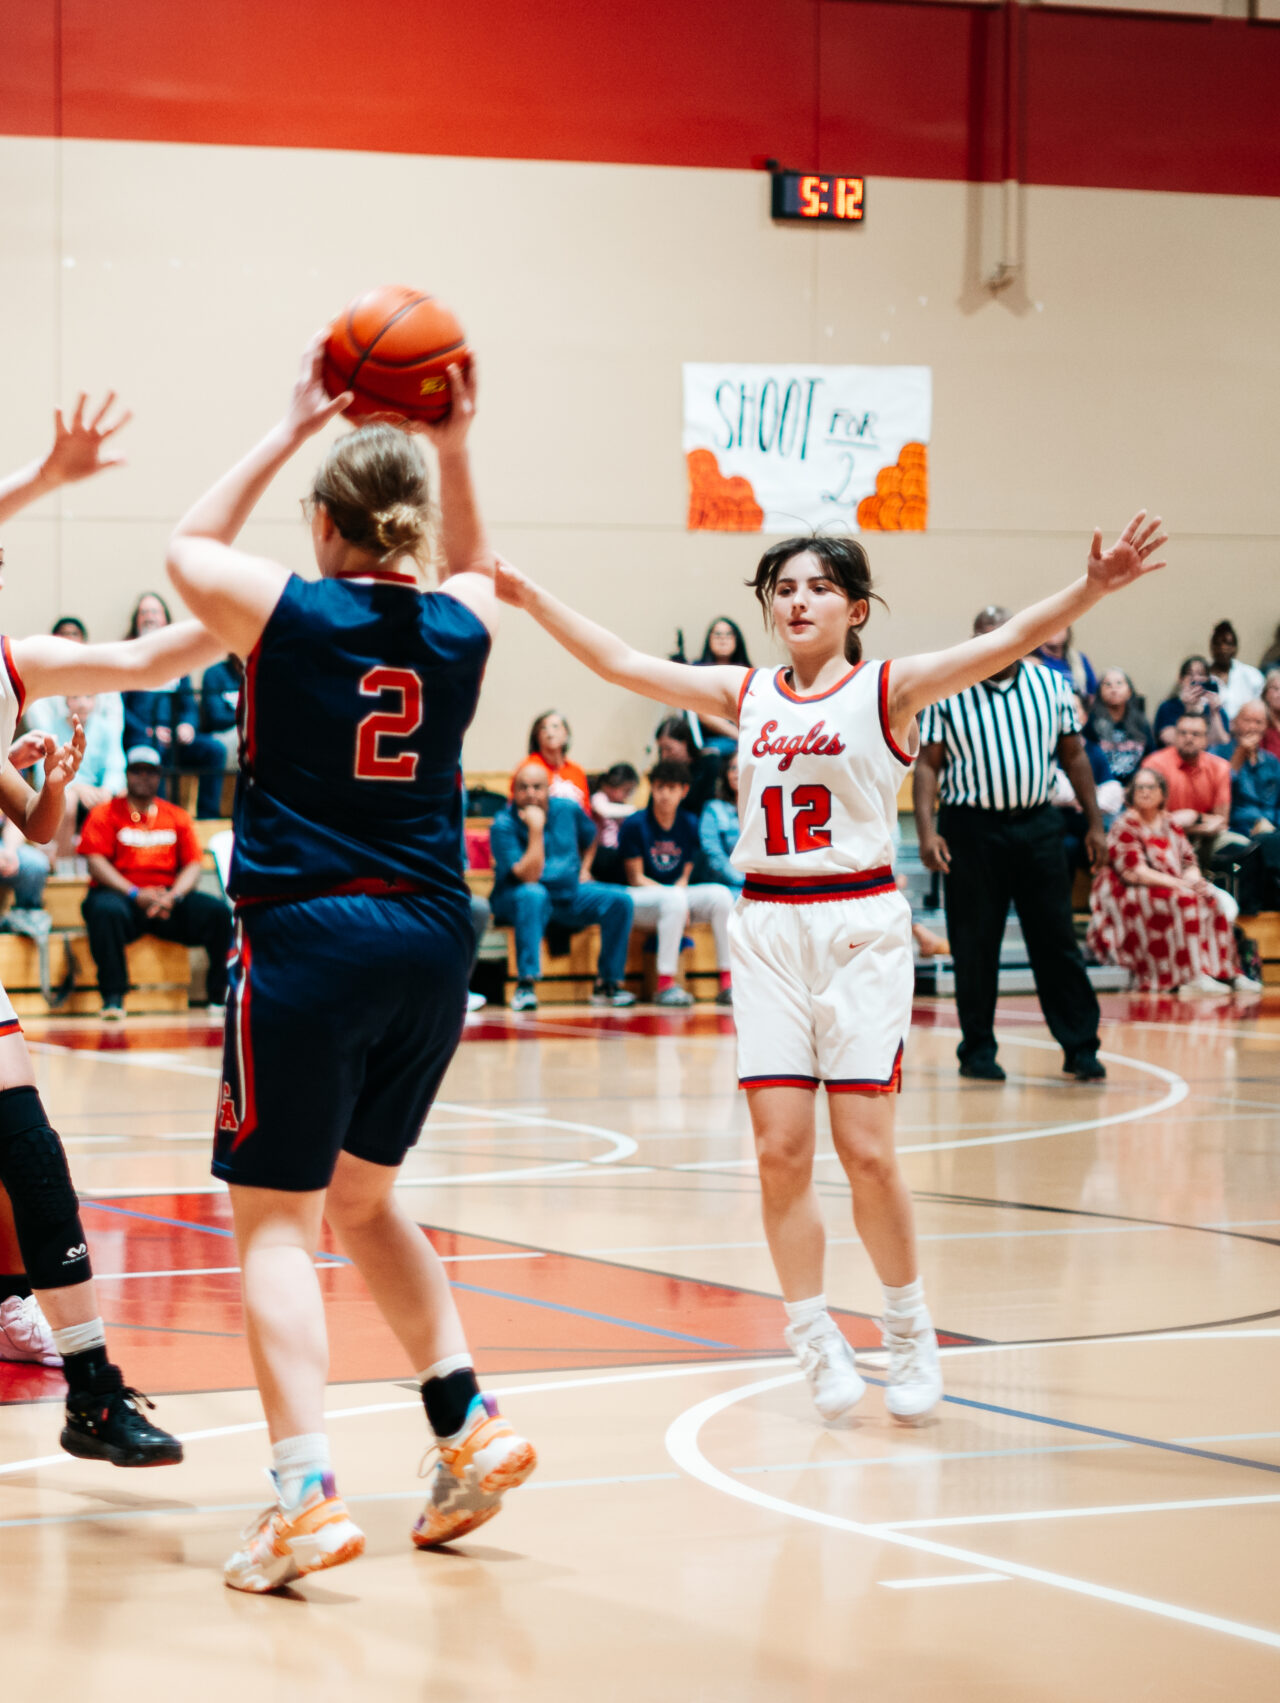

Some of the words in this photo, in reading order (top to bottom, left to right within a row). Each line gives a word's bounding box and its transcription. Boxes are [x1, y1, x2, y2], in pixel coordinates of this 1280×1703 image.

[799, 175, 863, 219] 5:12
[714, 377, 824, 460] SHOOT
[829, 408, 879, 440] FOR
[821, 452, 857, 509] 2
[355, 665, 422, 781] 2
[752, 719, 846, 772] Eagles
[760, 784, 833, 856] 12
